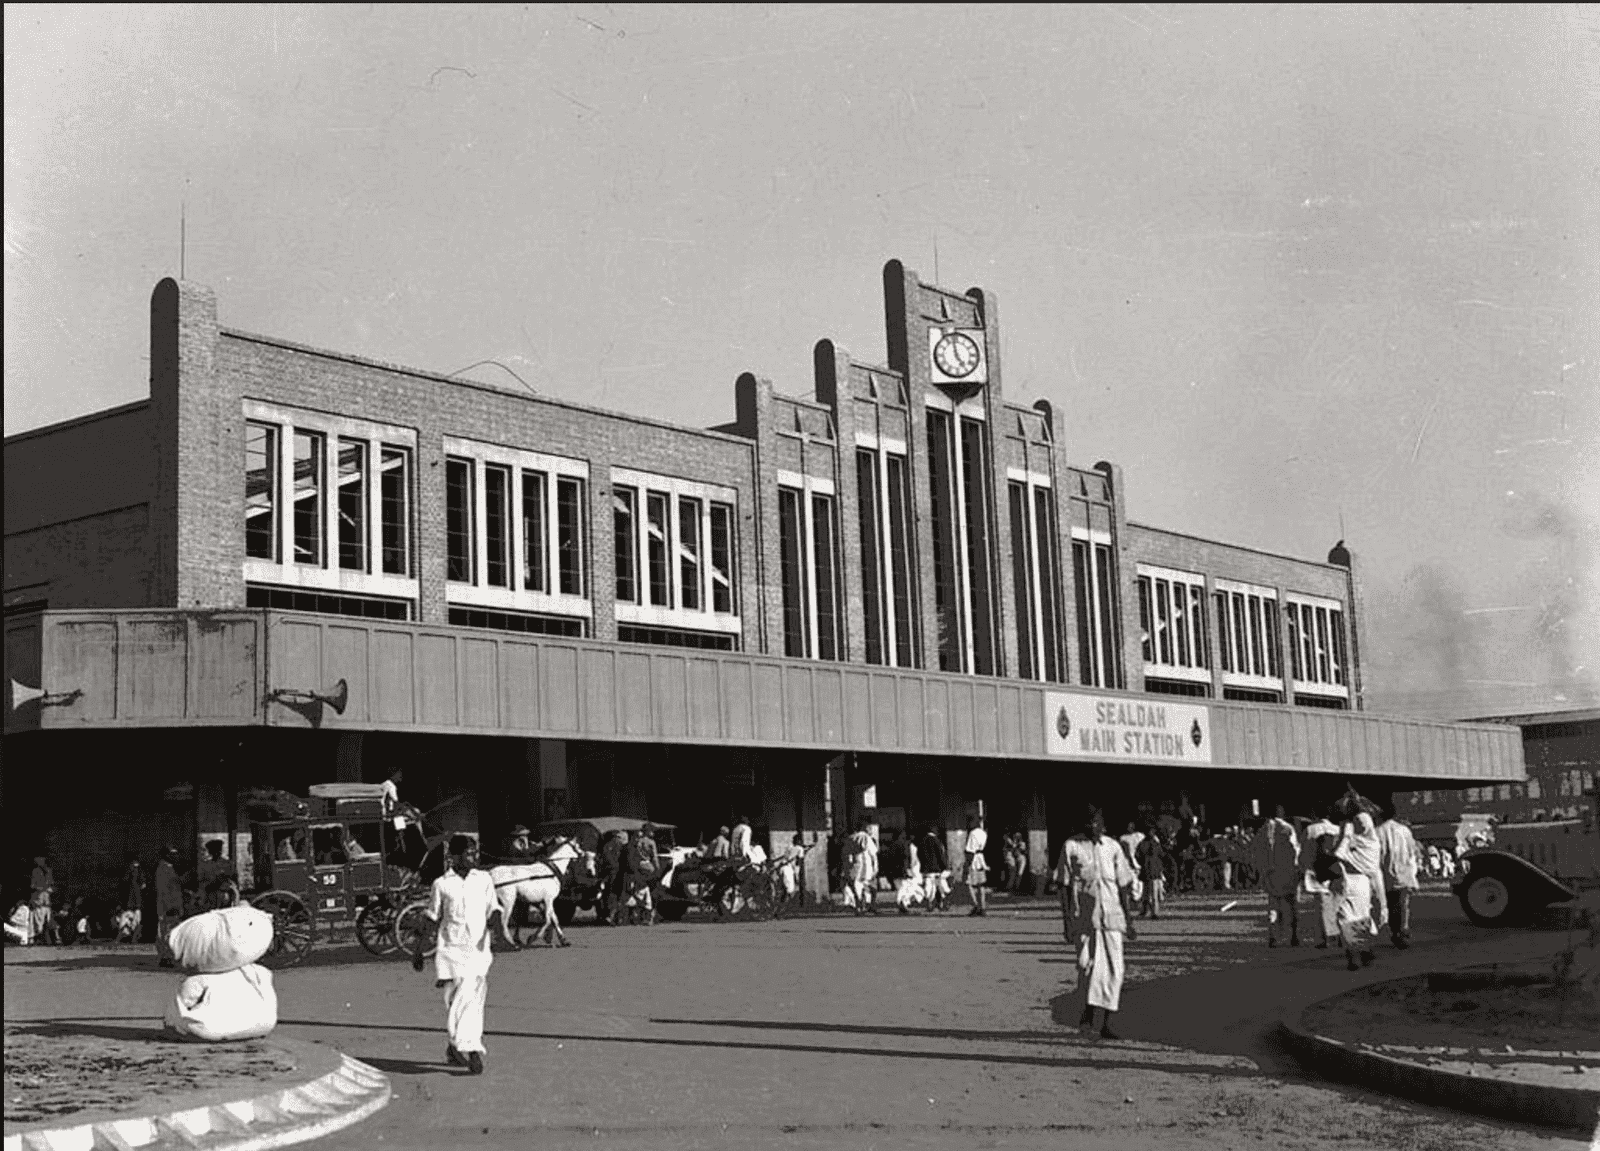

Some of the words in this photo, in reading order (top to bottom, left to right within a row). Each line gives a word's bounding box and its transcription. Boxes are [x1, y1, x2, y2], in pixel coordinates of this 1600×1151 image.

[1096, 701, 1166, 728] SEALDAH
[1079, 728, 1116, 753] MAIN
[1123, 731, 1184, 757] STATION
